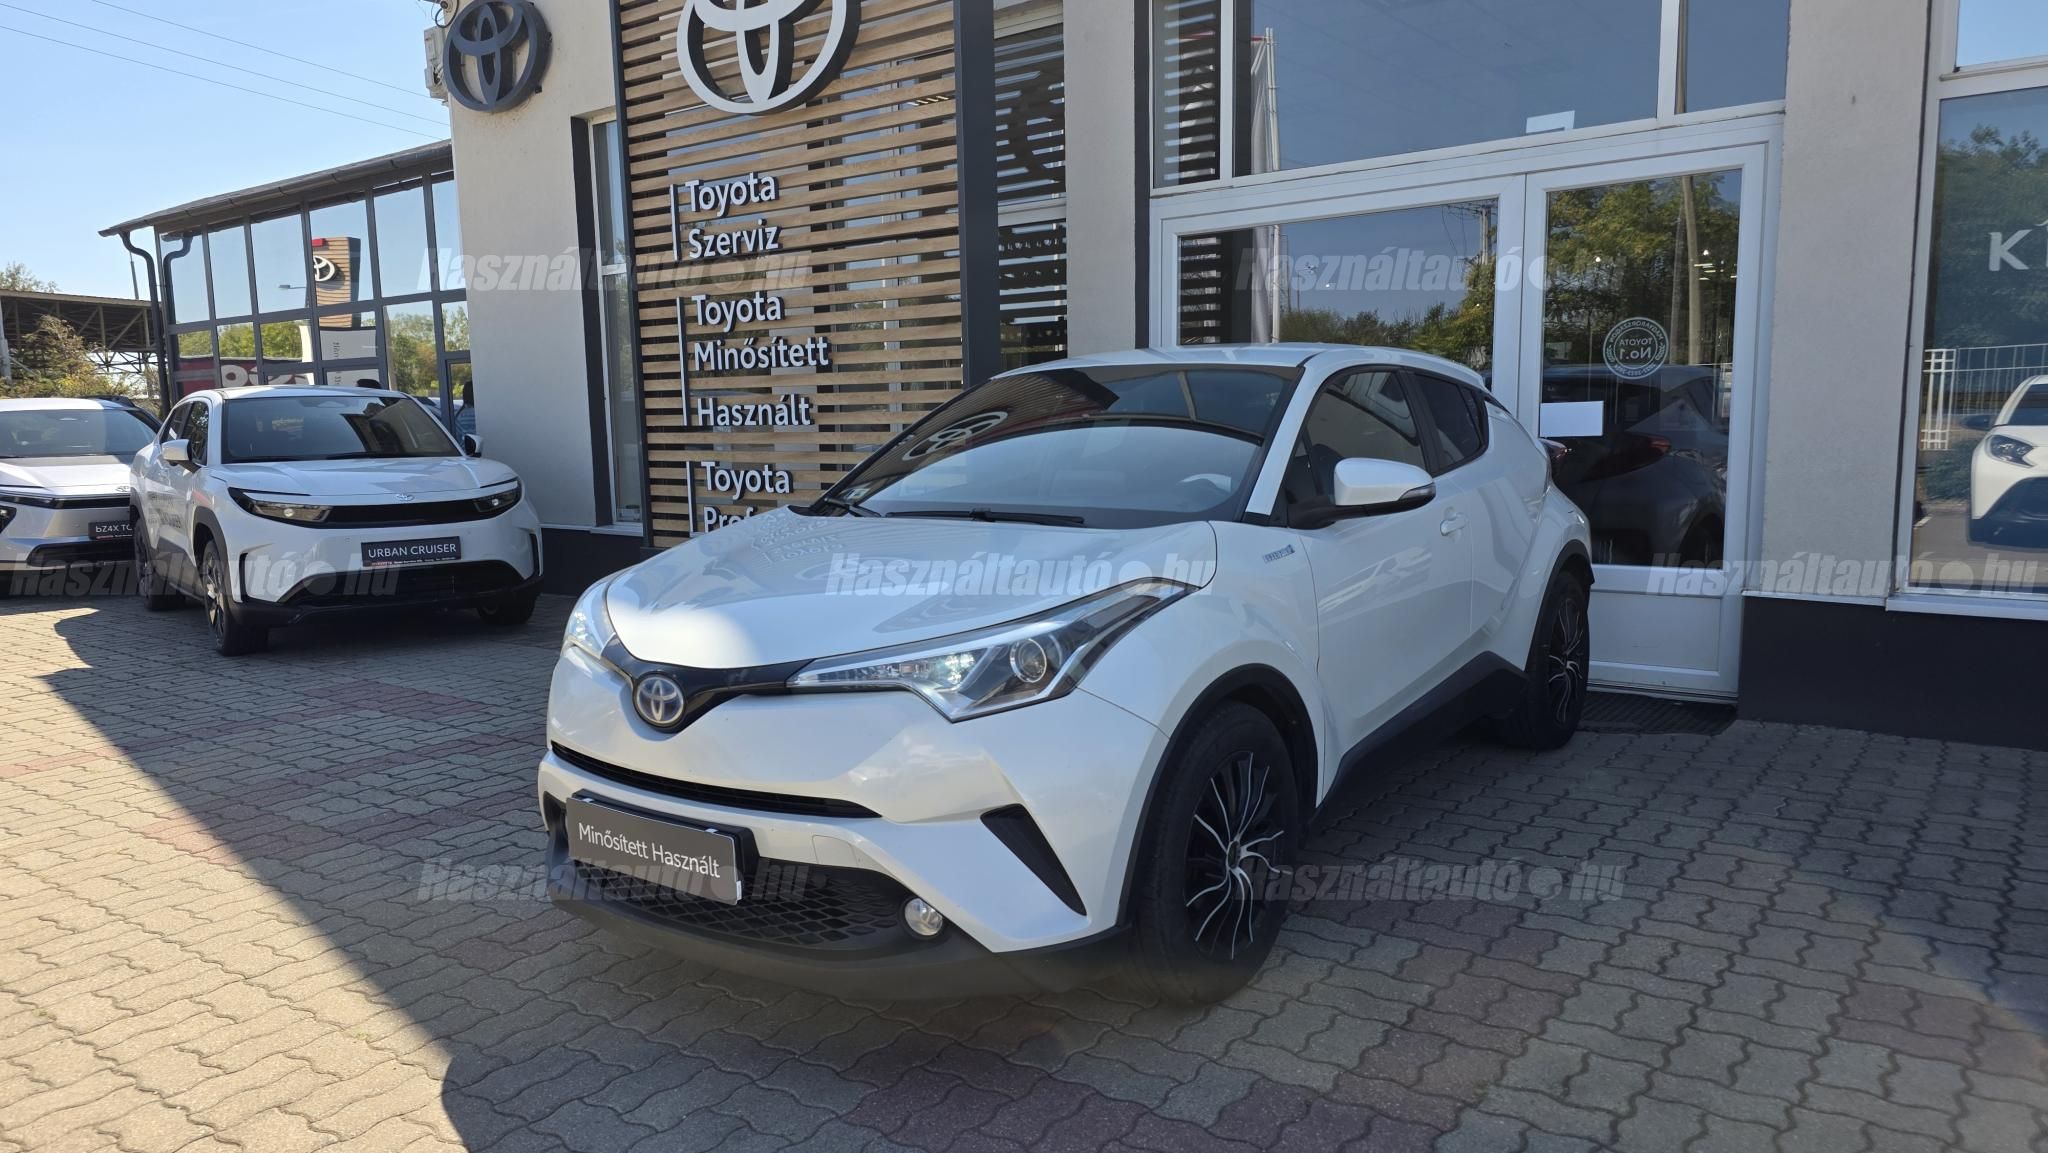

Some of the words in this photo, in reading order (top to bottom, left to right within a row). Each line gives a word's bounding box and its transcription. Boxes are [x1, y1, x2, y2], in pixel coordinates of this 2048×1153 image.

[685, 172, 777, 217] Toyota
[688, 218, 780, 259] Szerviz
[691, 291, 783, 333] Toyota
[694, 336, 829, 371] Minősített
[697, 393, 812, 426] Használt
[701, 461, 791, 500] Toyota
[95, 525, 119, 533] bZ4X
[368, 547, 408, 558] URBAN
[410, 543, 457, 555] CRUISER
[578, 822, 649, 859] Minősített
[651, 842, 721, 878] Használt
